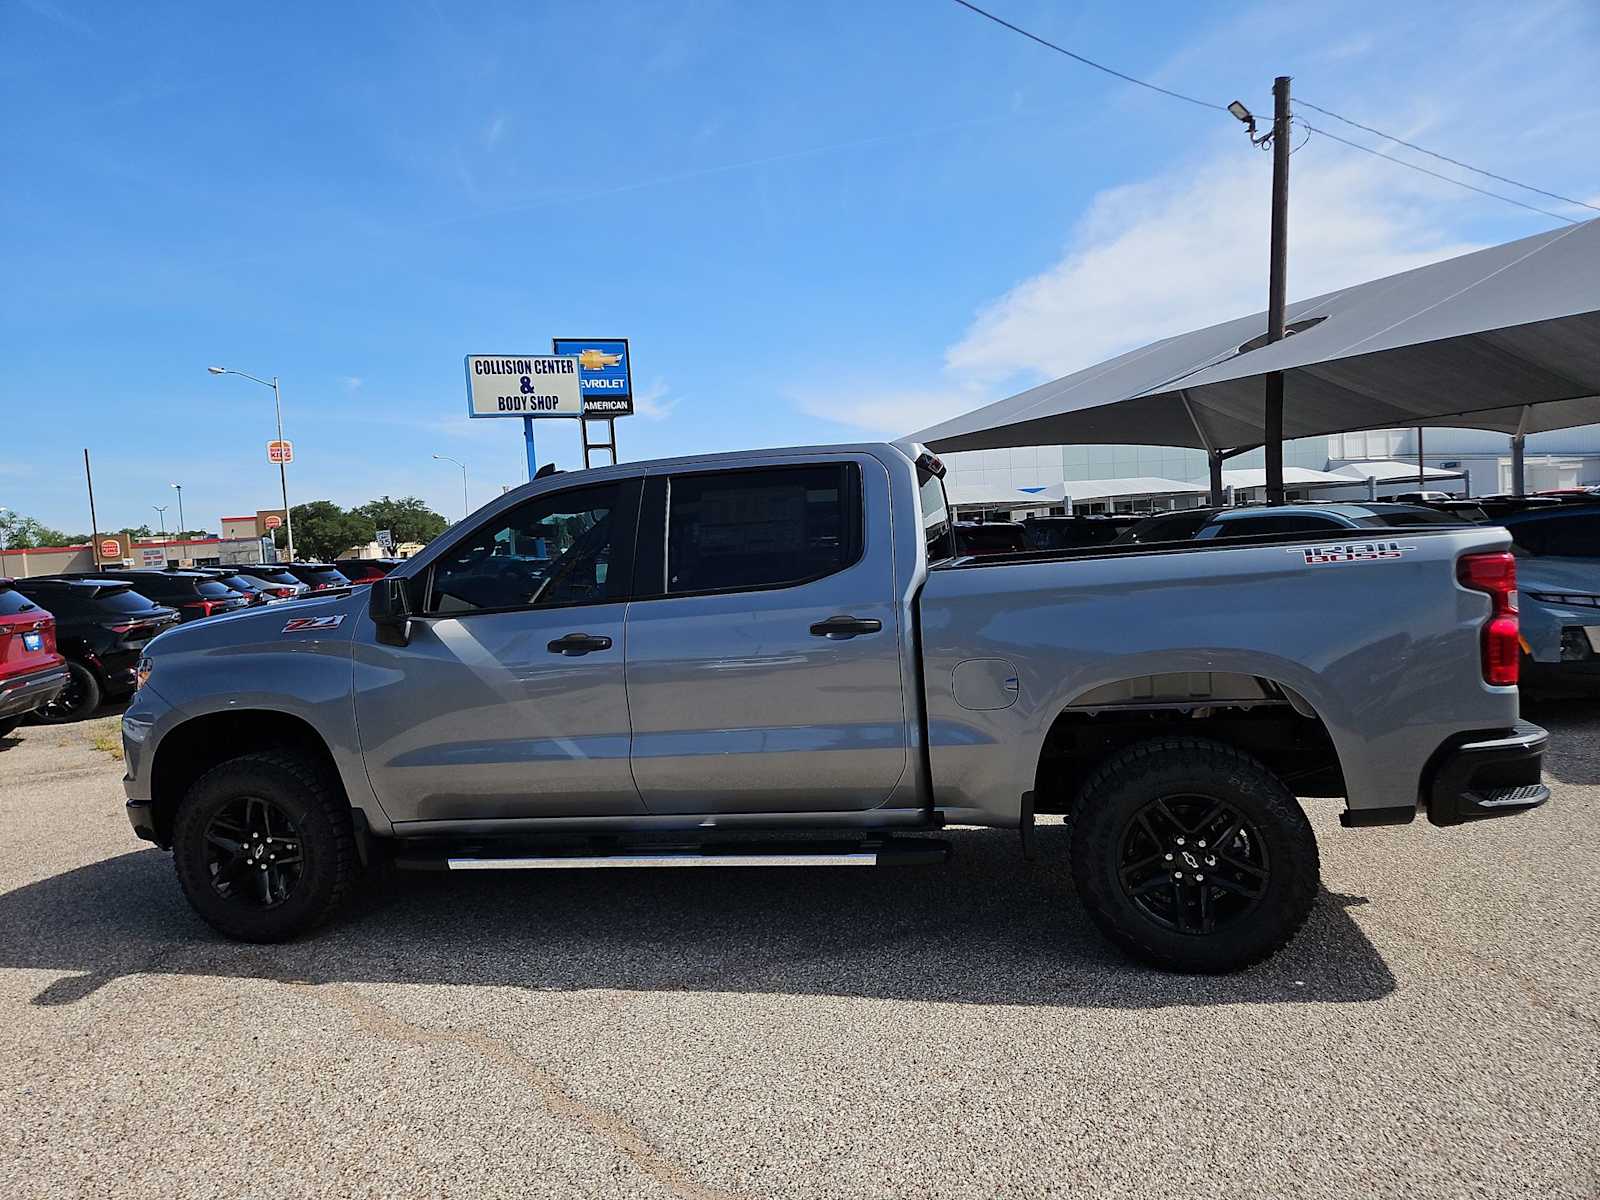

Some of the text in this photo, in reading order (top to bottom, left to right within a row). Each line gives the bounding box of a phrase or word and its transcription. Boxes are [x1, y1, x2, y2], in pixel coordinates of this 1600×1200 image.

[475, 360, 574, 375] COLLISION CENTER
[520, 376, 535, 394] &
[581, 379, 624, 389] EVROLET
[498, 396, 559, 411] BODY SHOP
[584, 401, 628, 410] AMERICAN
[1305, 551, 1402, 564] BOSS
